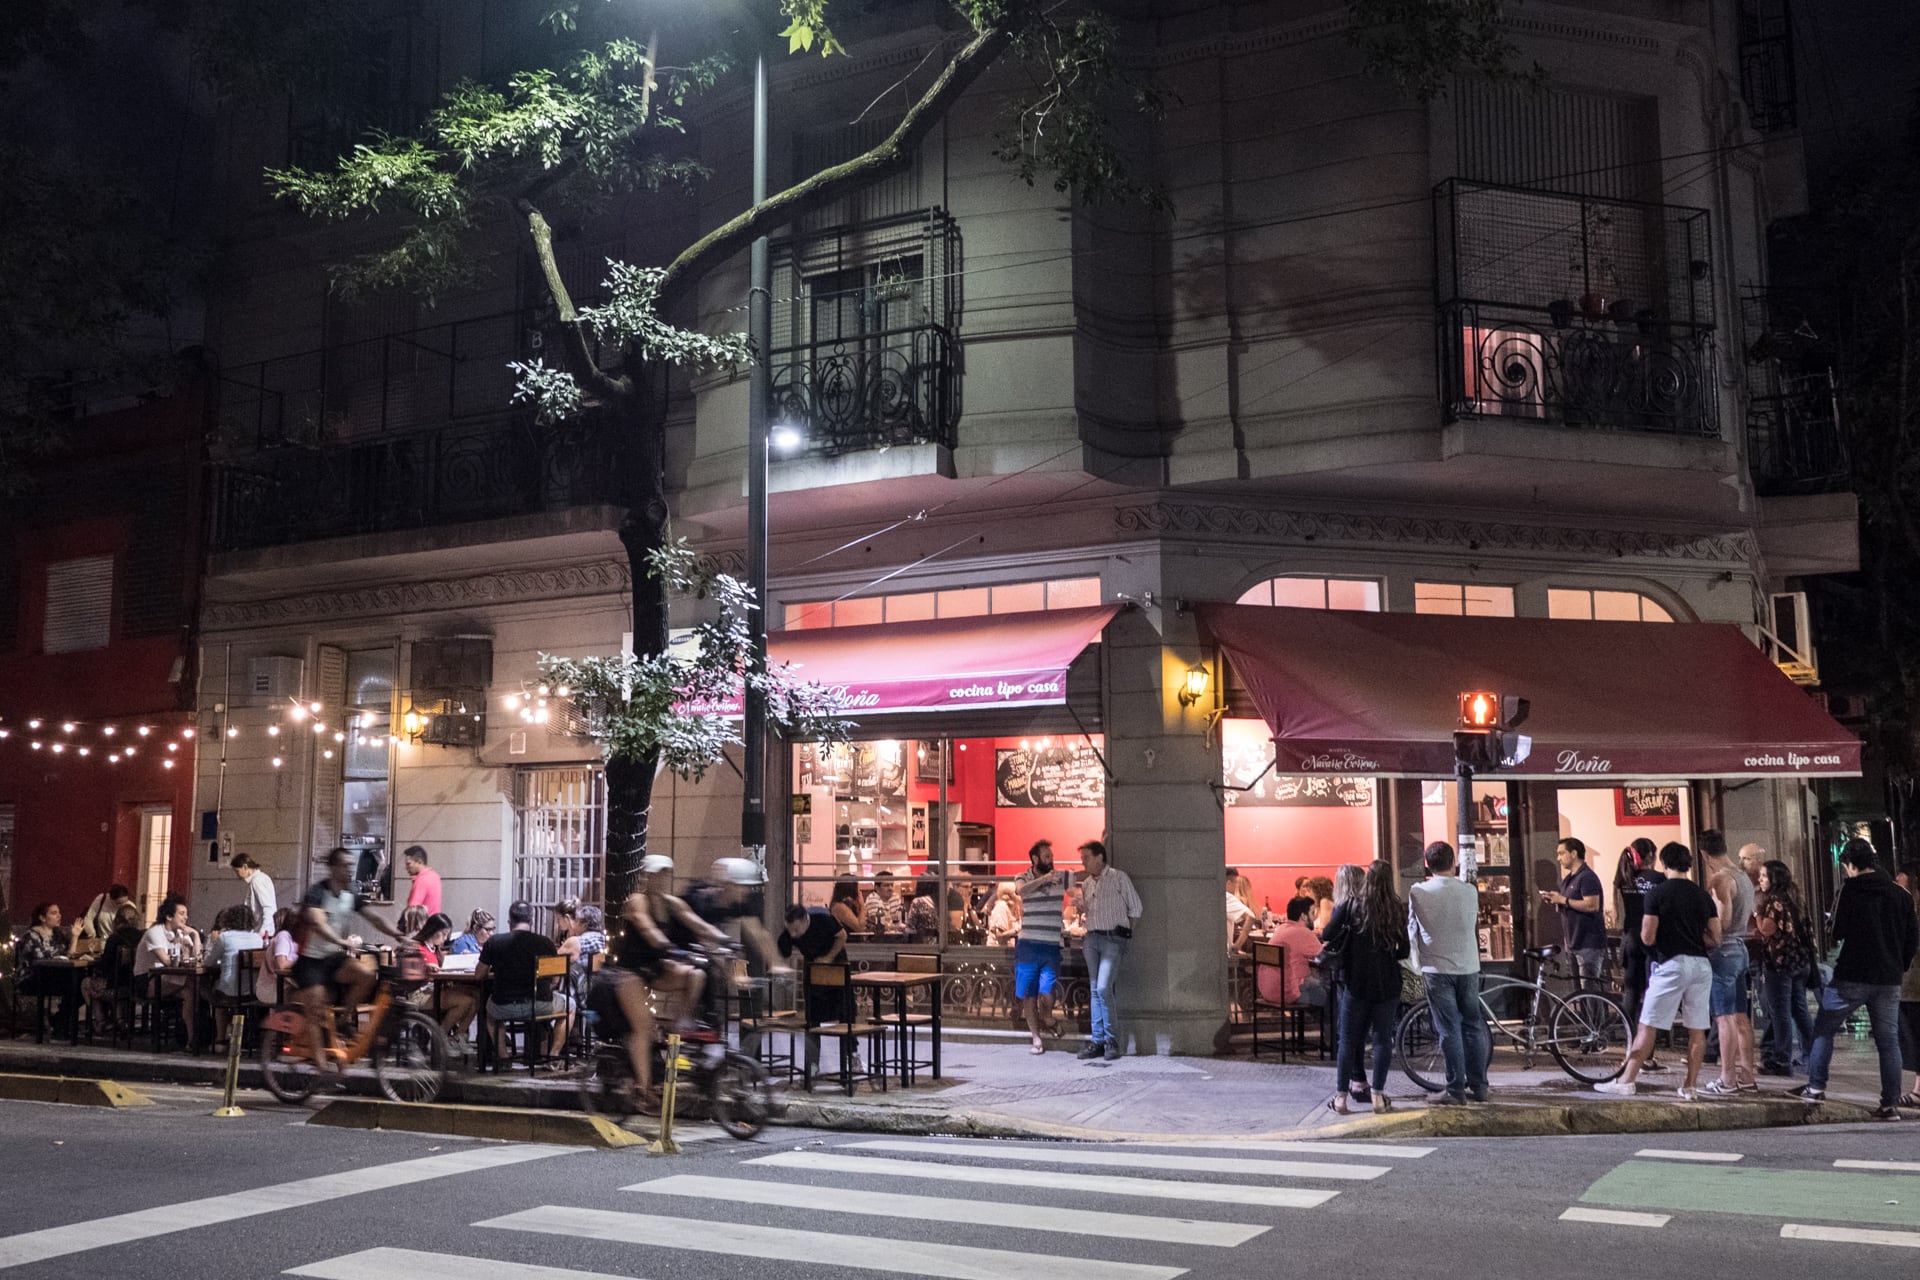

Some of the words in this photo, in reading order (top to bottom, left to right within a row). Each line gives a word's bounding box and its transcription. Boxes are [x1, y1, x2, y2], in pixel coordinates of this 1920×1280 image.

[827, 685, 880, 707] Doña
[949, 684, 994, 698] cocina
[997, 681, 1024, 700] tipo
[1027, 682, 1059, 693] casa
[1554, 749, 1612, 773] Doña
[1744, 754, 1785, 766] cocina
[1788, 752, 1811, 770] tipo
[1814, 755, 1841, 765] casa
